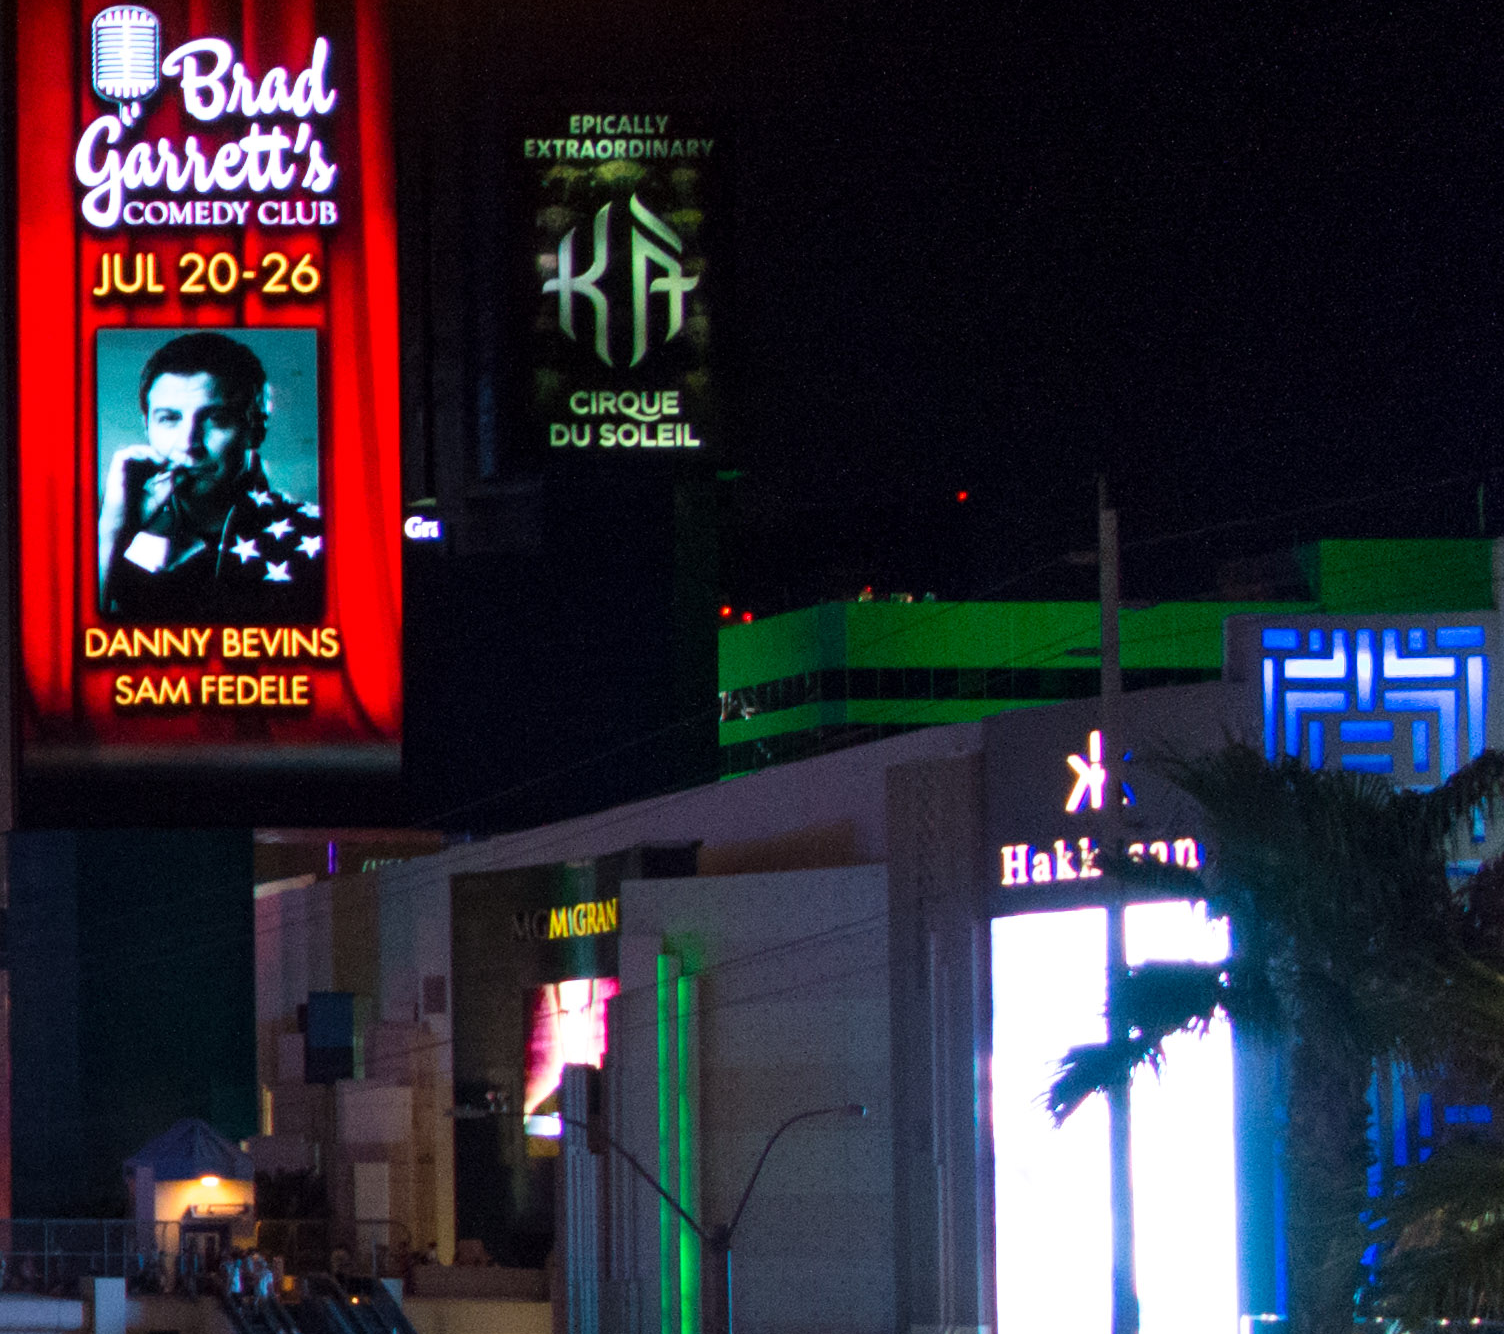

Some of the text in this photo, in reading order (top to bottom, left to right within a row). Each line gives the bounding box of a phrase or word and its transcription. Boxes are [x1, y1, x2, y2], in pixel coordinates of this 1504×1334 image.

[162, 36, 337, 120] Brad
[569, 115, 668, 134] EPICALLY
[524, 139, 714, 158] EXTRAORDINARY
[75, 115, 337, 227] Garrett's
[123, 201, 338, 225] COMEDY CLUB
[92, 252, 320, 296] JUL 20-26
[569, 391, 680, 422] CIRQUE
[550, 423, 700, 447] DU SOLEIL
[85, 628, 339, 658] DANNY BEVINS
[115, 675, 309, 705] SAM FEDELE
[1001, 836, 1202, 885] Hakksan
[573, 897, 619, 937] GRAN
